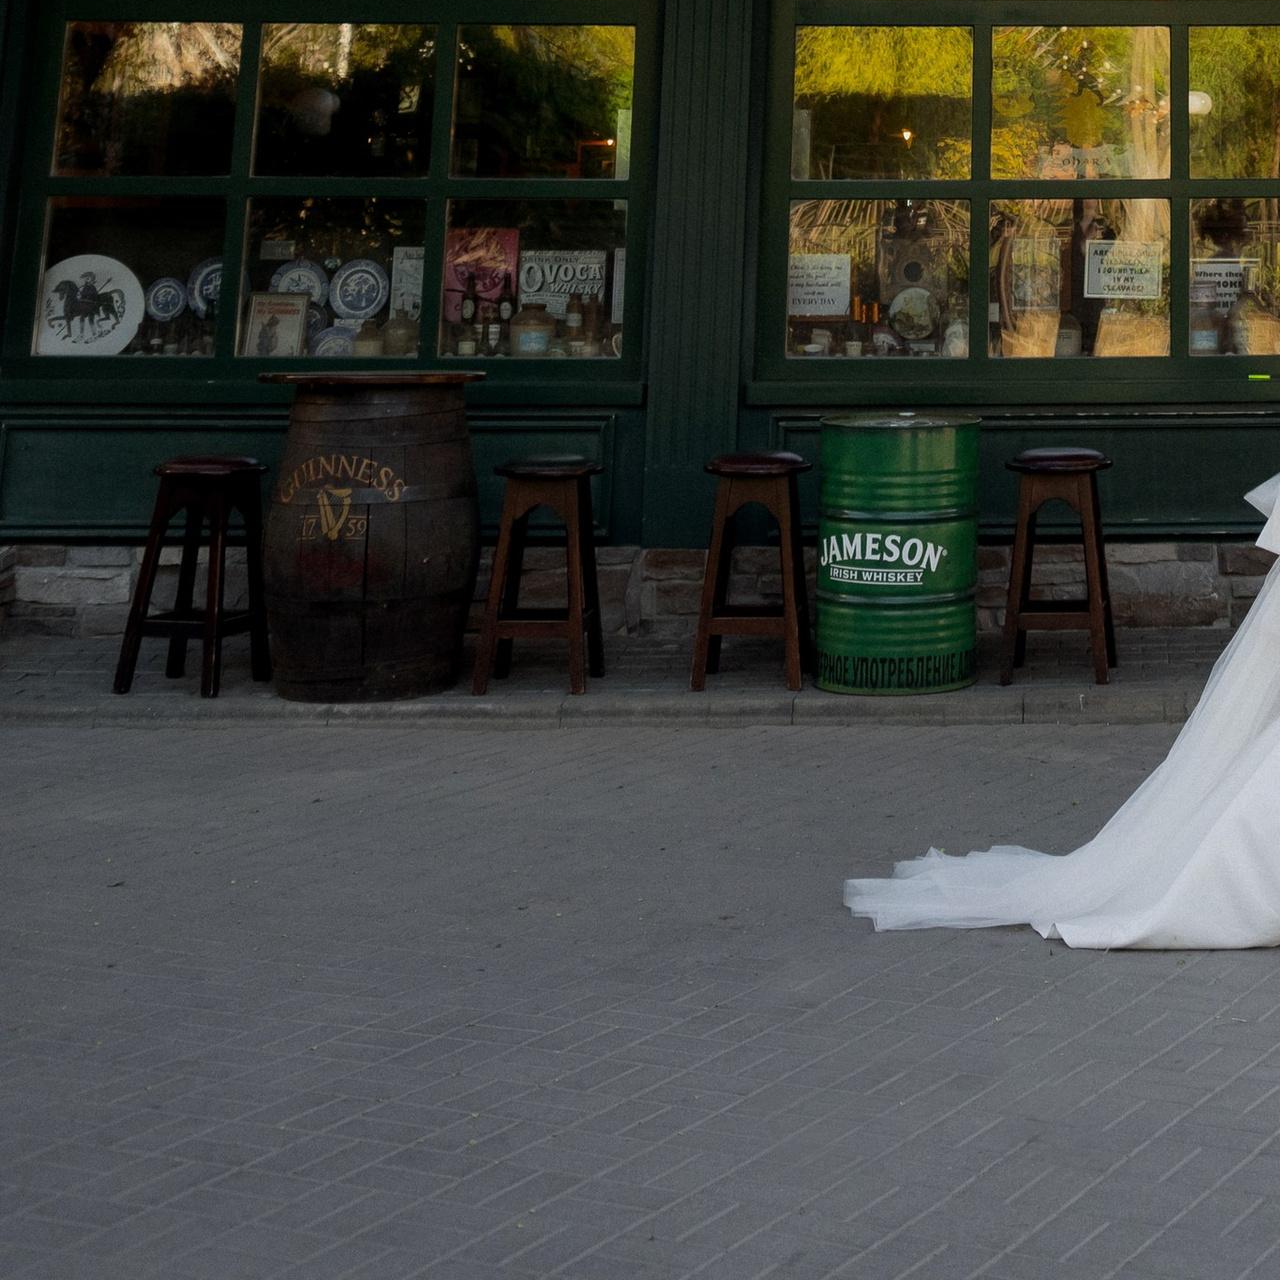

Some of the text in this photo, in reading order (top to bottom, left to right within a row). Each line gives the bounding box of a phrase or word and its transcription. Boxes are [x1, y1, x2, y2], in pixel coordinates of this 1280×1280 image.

[519, 262, 604, 293] OVOCA
[550, 282, 602, 295] WHISKY
[280, 454, 408, 504] GUINNESS
[302, 517, 367, 537] 17 59
[820, 533, 944, 572] JAMESON
[830, 566, 924, 583] IRISH WHISKEY
[852, 653, 956, 689] УПОТРЕБЛЕНИЕ
